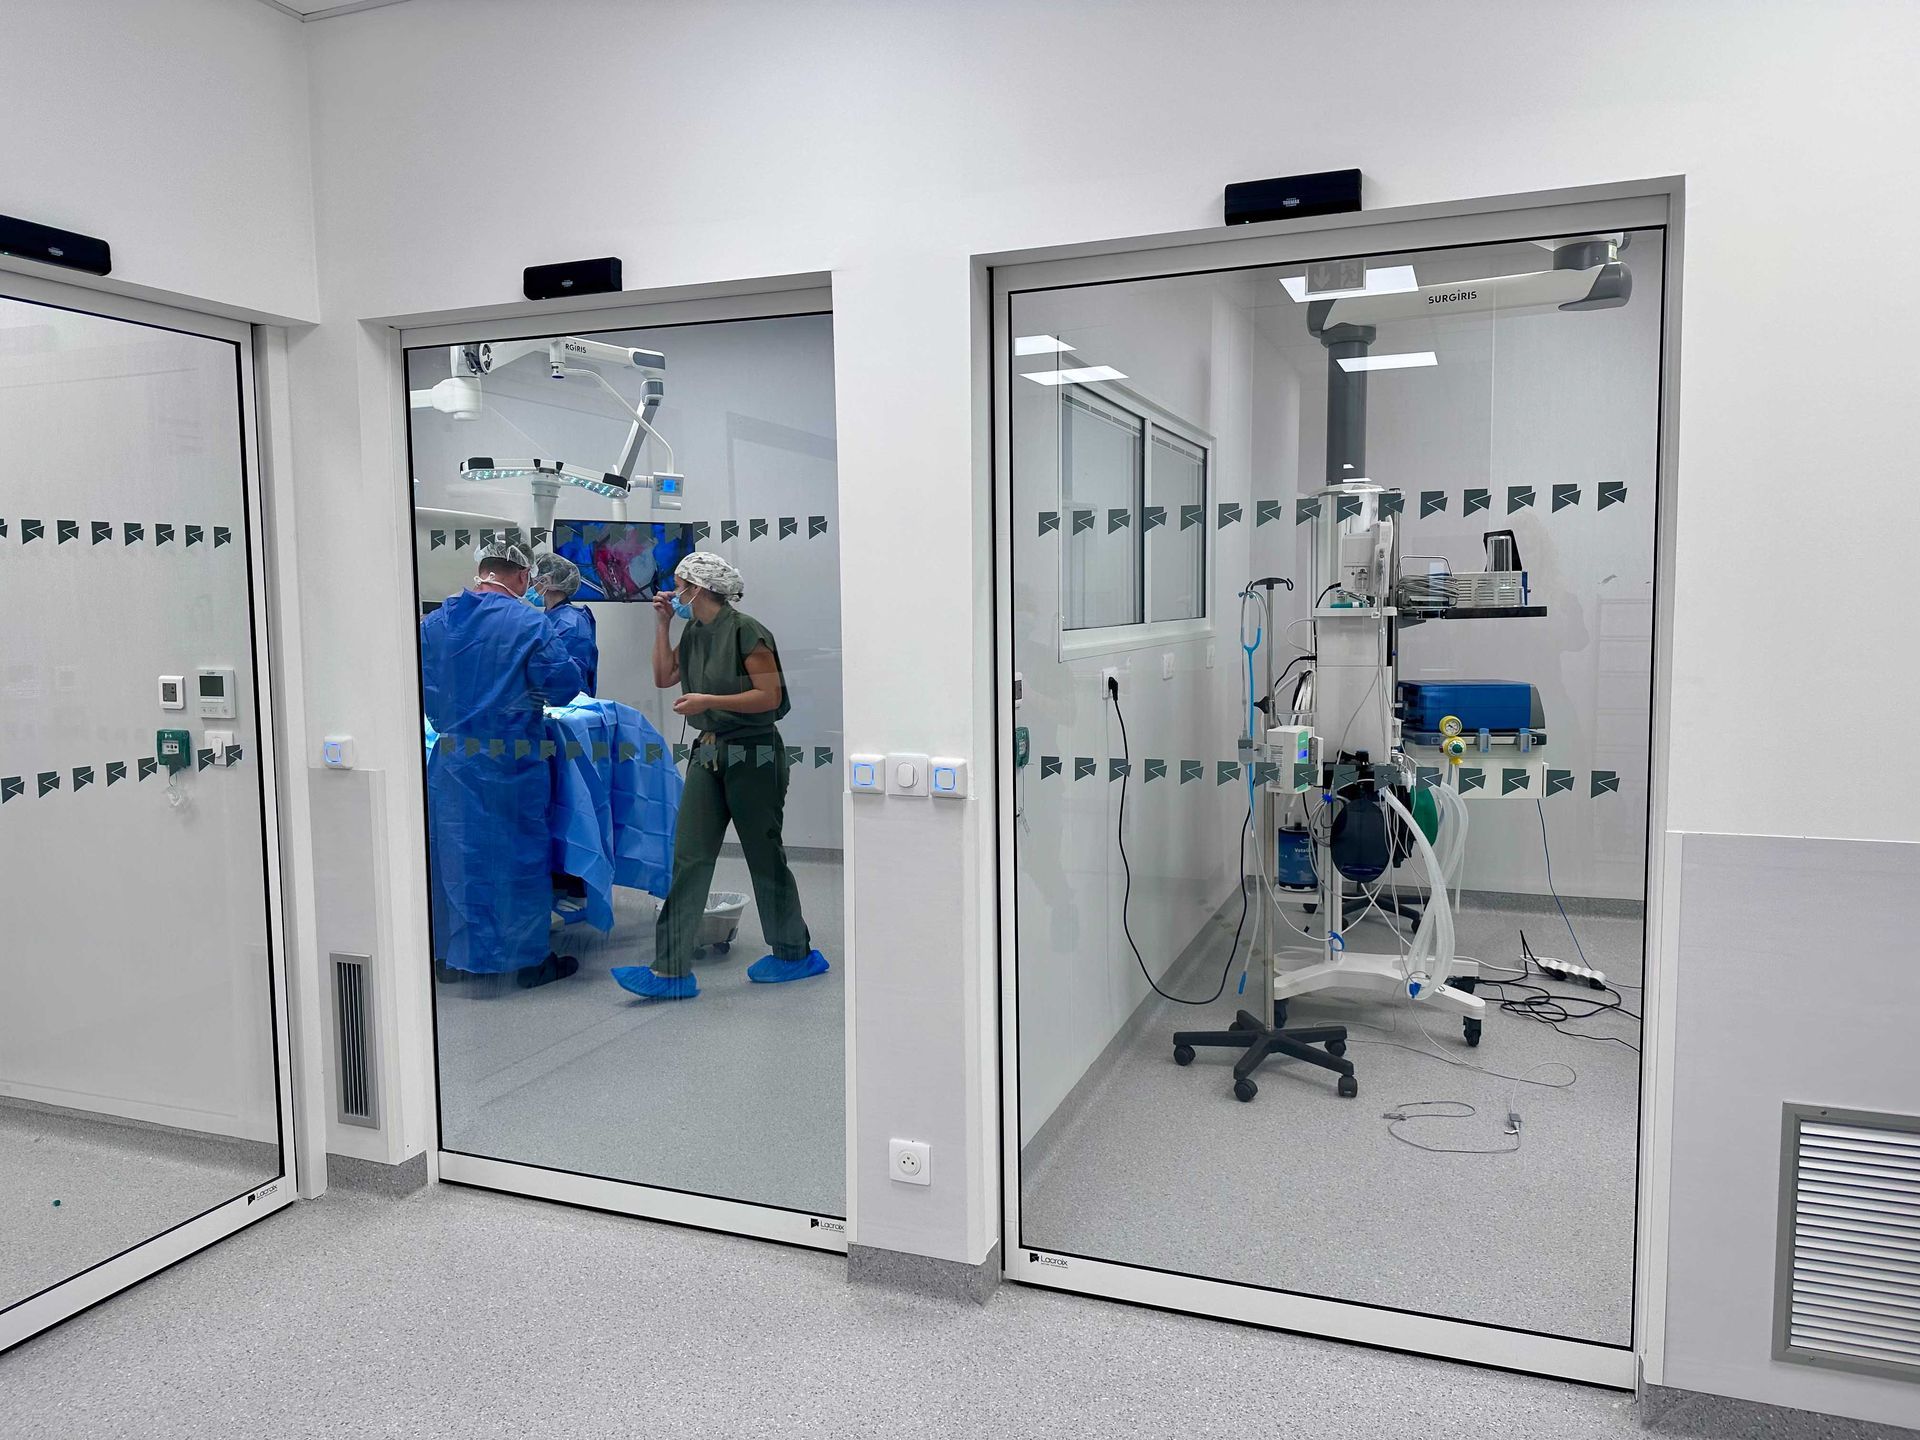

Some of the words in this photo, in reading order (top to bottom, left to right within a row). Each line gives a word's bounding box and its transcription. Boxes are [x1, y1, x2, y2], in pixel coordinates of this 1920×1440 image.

[565, 342, 587, 353] RGIRIS
[256, 1184, 277, 1199] Lacroix
[820, 1220, 845, 1231] Lacroix
[1040, 1255, 1068, 1266] Lacroix
